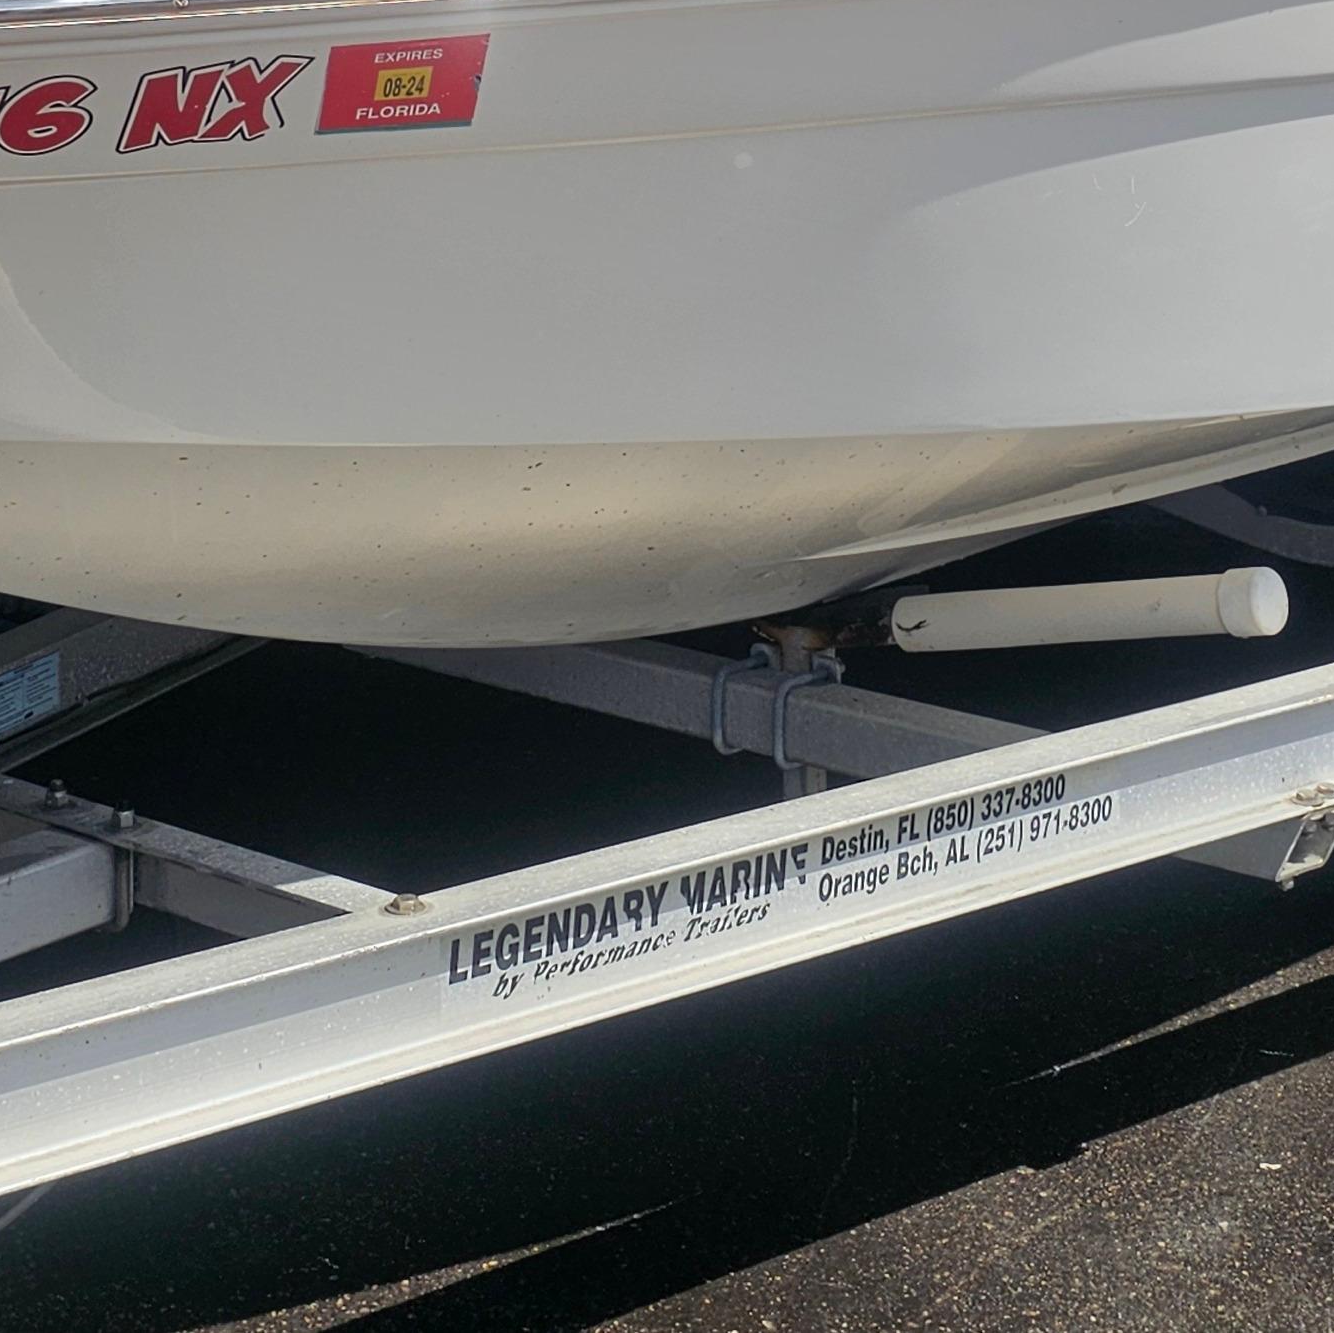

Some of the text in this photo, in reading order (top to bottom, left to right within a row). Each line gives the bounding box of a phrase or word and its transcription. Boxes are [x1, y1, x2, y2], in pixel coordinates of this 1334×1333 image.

[374, 48, 443, 63] EXPIRES
[115, 56, 314, 154] NX
[355, 103, 441, 120] FLORIDA
[383, 75, 425, 98] 08-24
[818, 795, 1113, 903] Orange Bch, AL (251) 971-8300
[821, 773, 1065, 865] Destin, FL (850) 337-8300
[448, 880, 669, 985] LEGENDARY
[492, 972, 521, 1000] by
